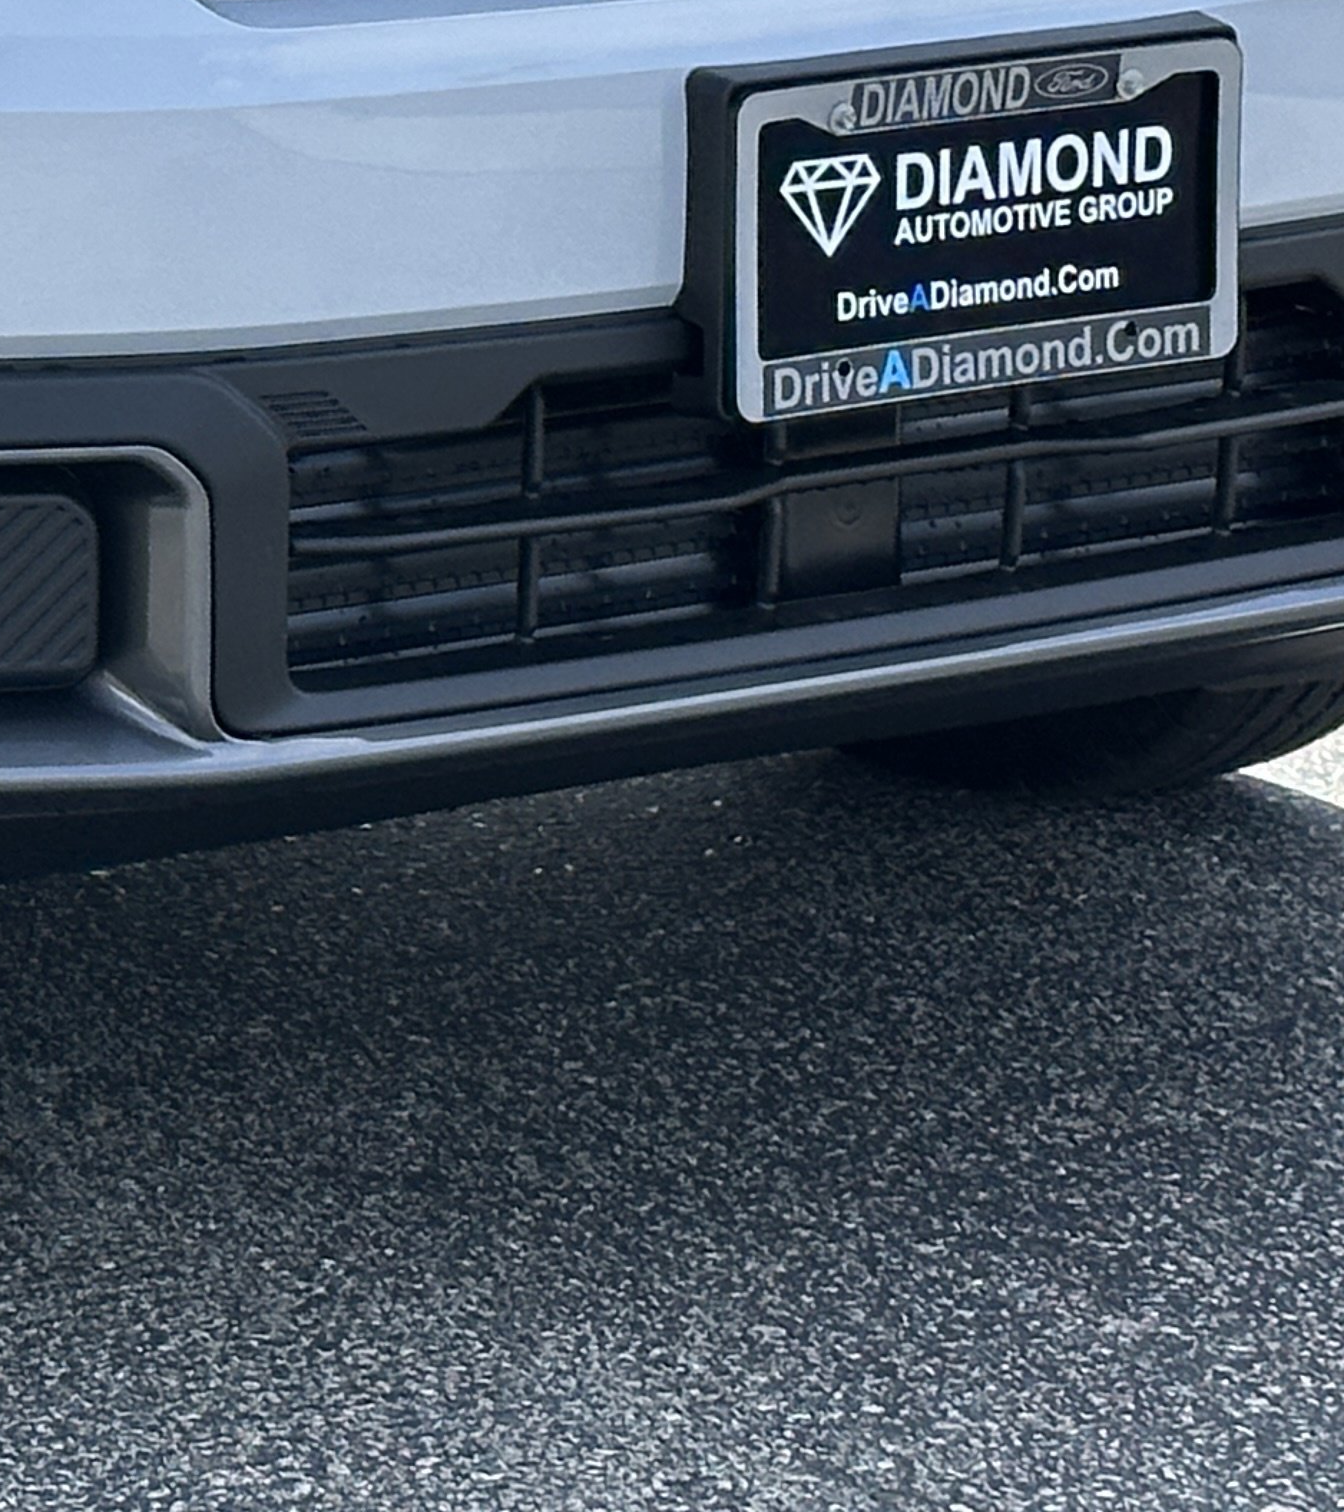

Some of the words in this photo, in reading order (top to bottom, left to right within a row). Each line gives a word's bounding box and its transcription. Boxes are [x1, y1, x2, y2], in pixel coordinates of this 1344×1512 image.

[858, 65, 1031, 127] DIAMOND
[895, 125, 1173, 211] DIAMOND
[893, 198, 1072, 246] AUTOMOTIVE
[1078, 187, 1174, 224] GROUP
[836, 264, 1120, 322] DriveADiamond.Com
[773, 319, 1201, 411] DriveADiamond.Com
